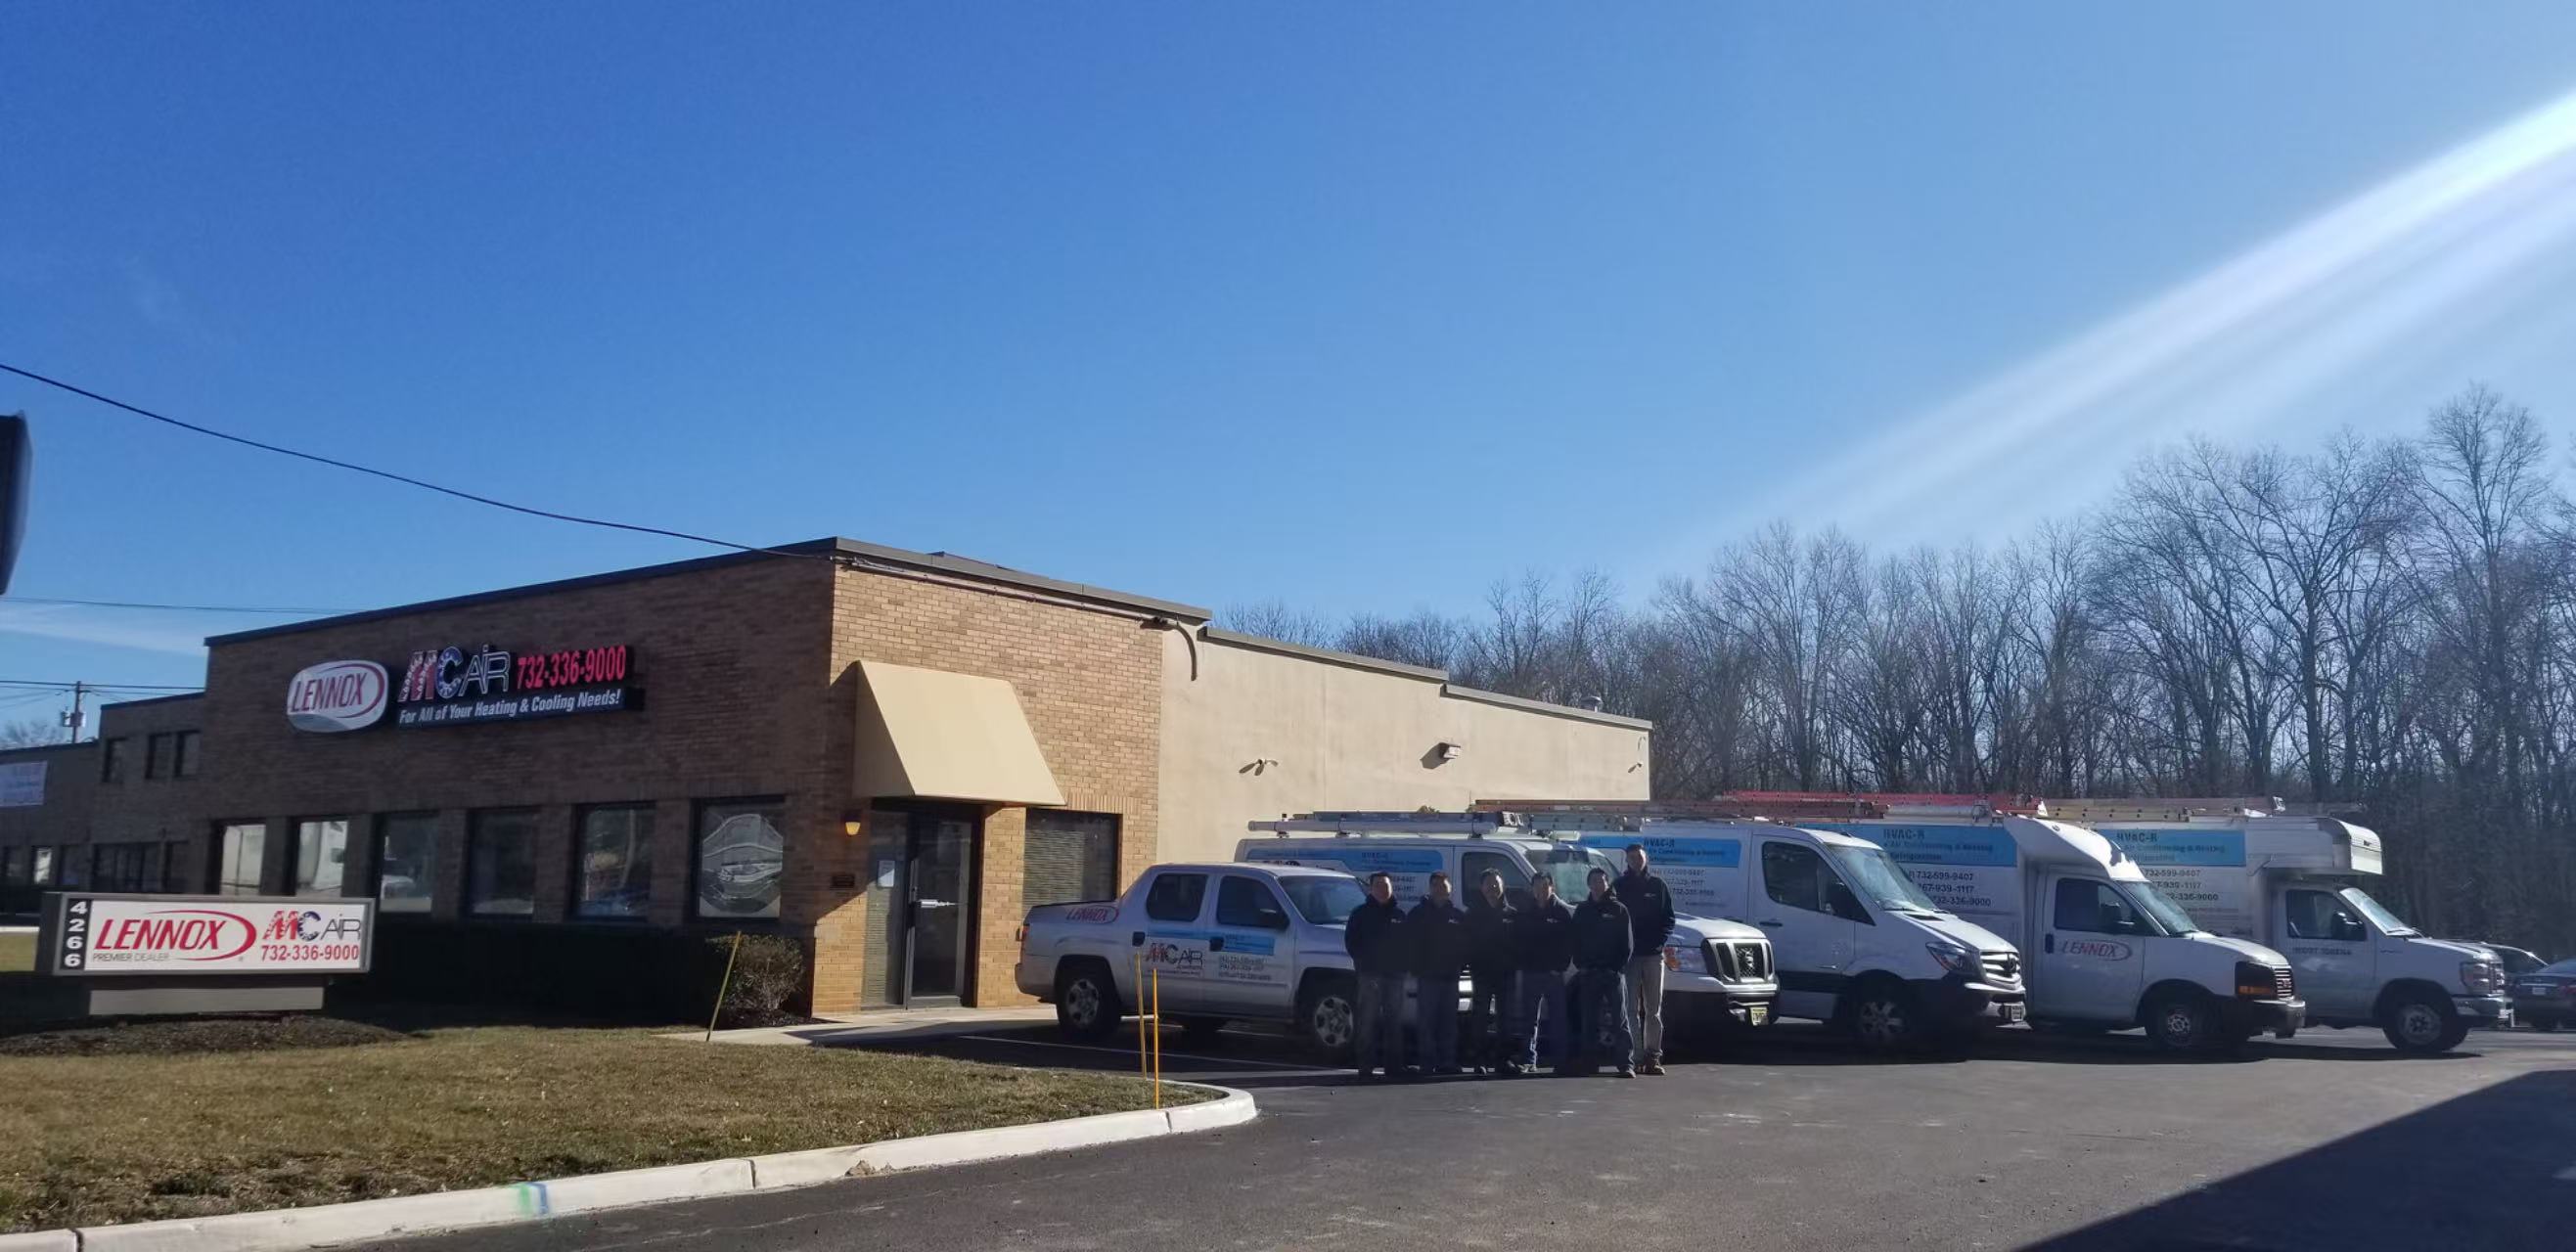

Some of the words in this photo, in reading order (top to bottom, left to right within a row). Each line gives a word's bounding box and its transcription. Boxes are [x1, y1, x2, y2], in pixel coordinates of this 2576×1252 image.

[517, 645, 627, 690] 732-336-9000
[291, 671, 367, 714] LENNOX
[399, 710, 416, 724] For
[418, 708, 432, 722] All
[434, 706, 447, 720] of
[449, 704, 473, 720] Your
[475, 699, 517, 718] Heating
[519, 698, 529, 711] &
[531, 693, 574, 712] Cooling
[577, 689, 621, 706] Needs!
[1065, 907, 1109, 922] LENNOX
[94, 918, 226, 951] LENNOX
[93, 953, 132, 962] PREMIER
[134, 953, 169, 962] DEALER
[261, 944, 359, 961] 732-336-9000
[2060, 941, 2119, 959] LENNOX
